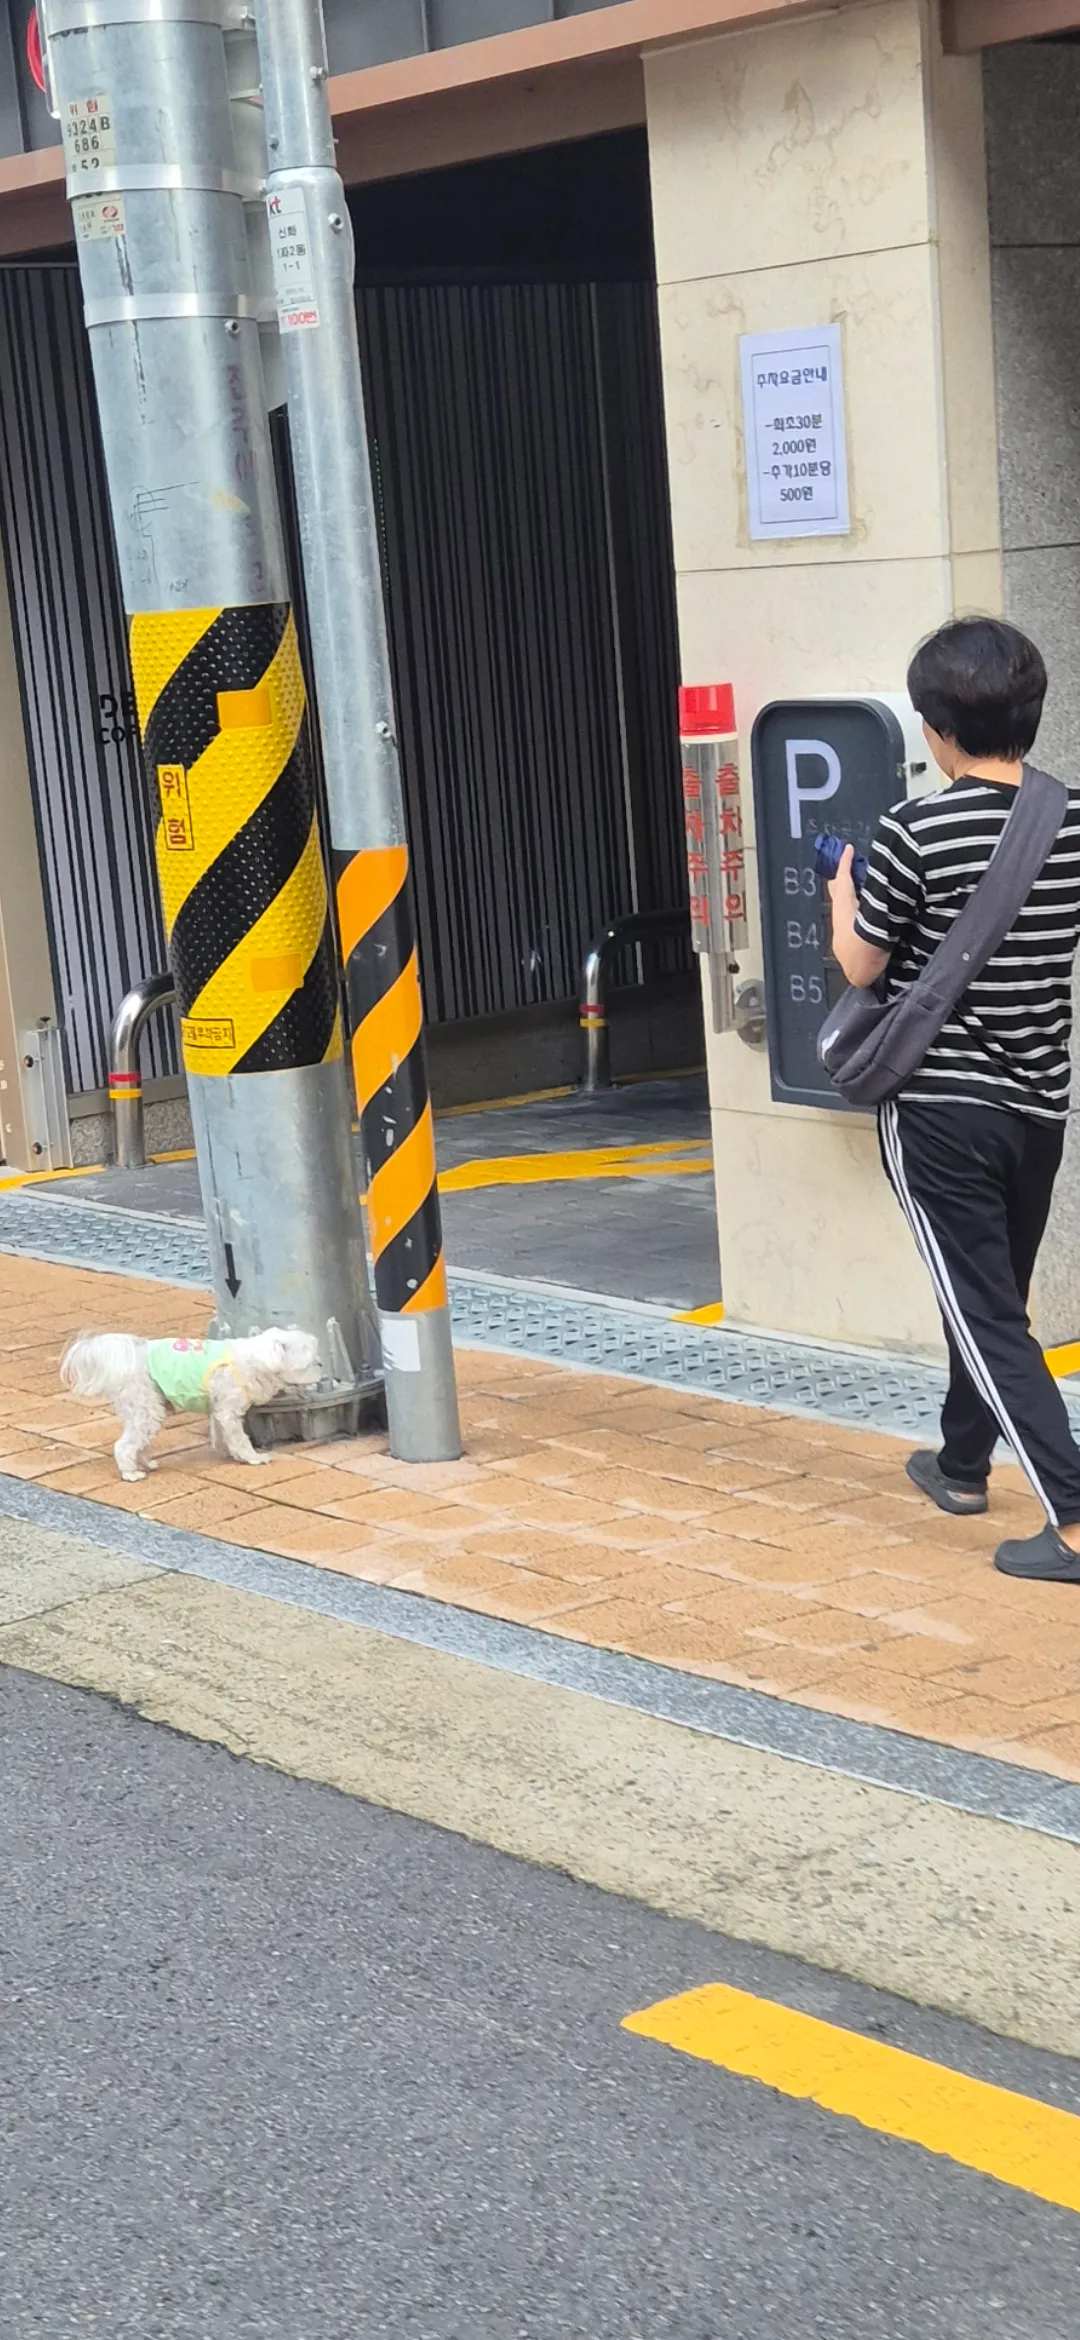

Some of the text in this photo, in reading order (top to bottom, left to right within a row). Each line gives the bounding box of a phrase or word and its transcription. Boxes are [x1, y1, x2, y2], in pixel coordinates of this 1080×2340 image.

[74, 135, 100, 153] 686
[269, 196, 282, 215] kt
[756, 366, 828, 388] 주차요금안내
[772, 438, 817, 456] 2,000원
[780, 486, 814, 502] 500원
[784, 739, 842, 839] P
[161, 770, 187, 846] 위험
[716, 763, 748, 922] 출차주의
[783, 866, 817, 896] B3
[786, 920, 821, 949] B4
[789, 974, 823, 1003] B5
